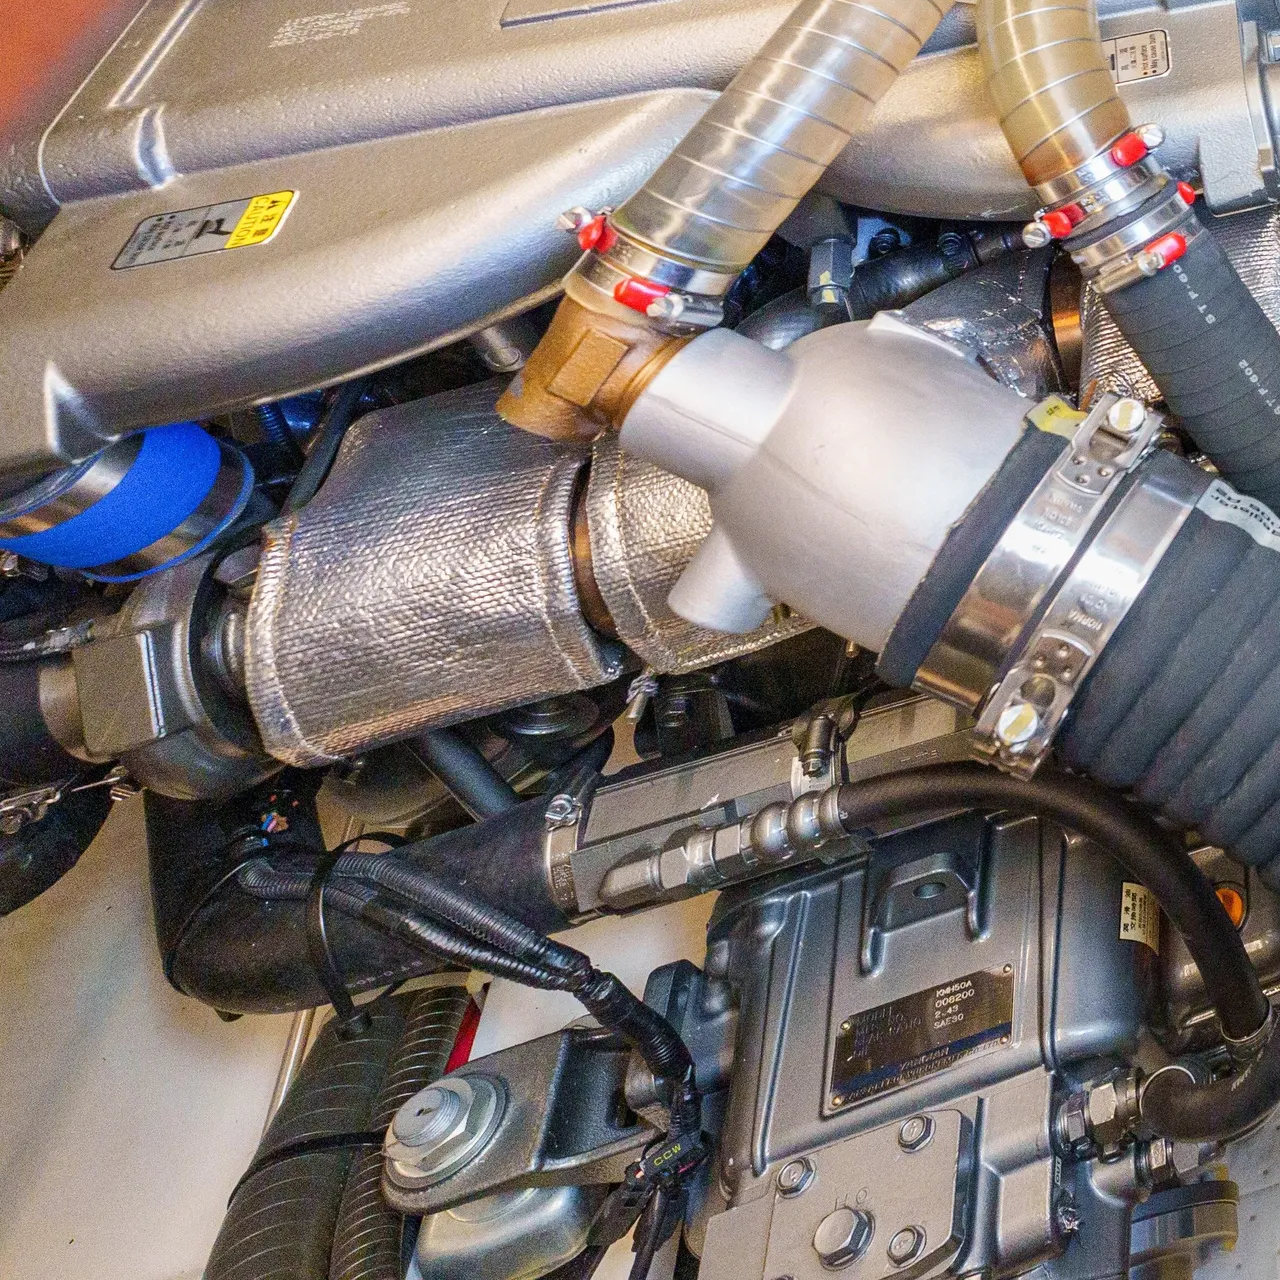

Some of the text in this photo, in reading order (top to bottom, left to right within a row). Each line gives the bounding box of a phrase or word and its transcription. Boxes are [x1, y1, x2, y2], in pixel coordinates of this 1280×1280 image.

[232, 197, 270, 246] CAUTION
[1067, 609, 1104, 631] NORMA
[935, 989, 975, 1008] 008200
[653, 1143, 682, 1167] CCW
